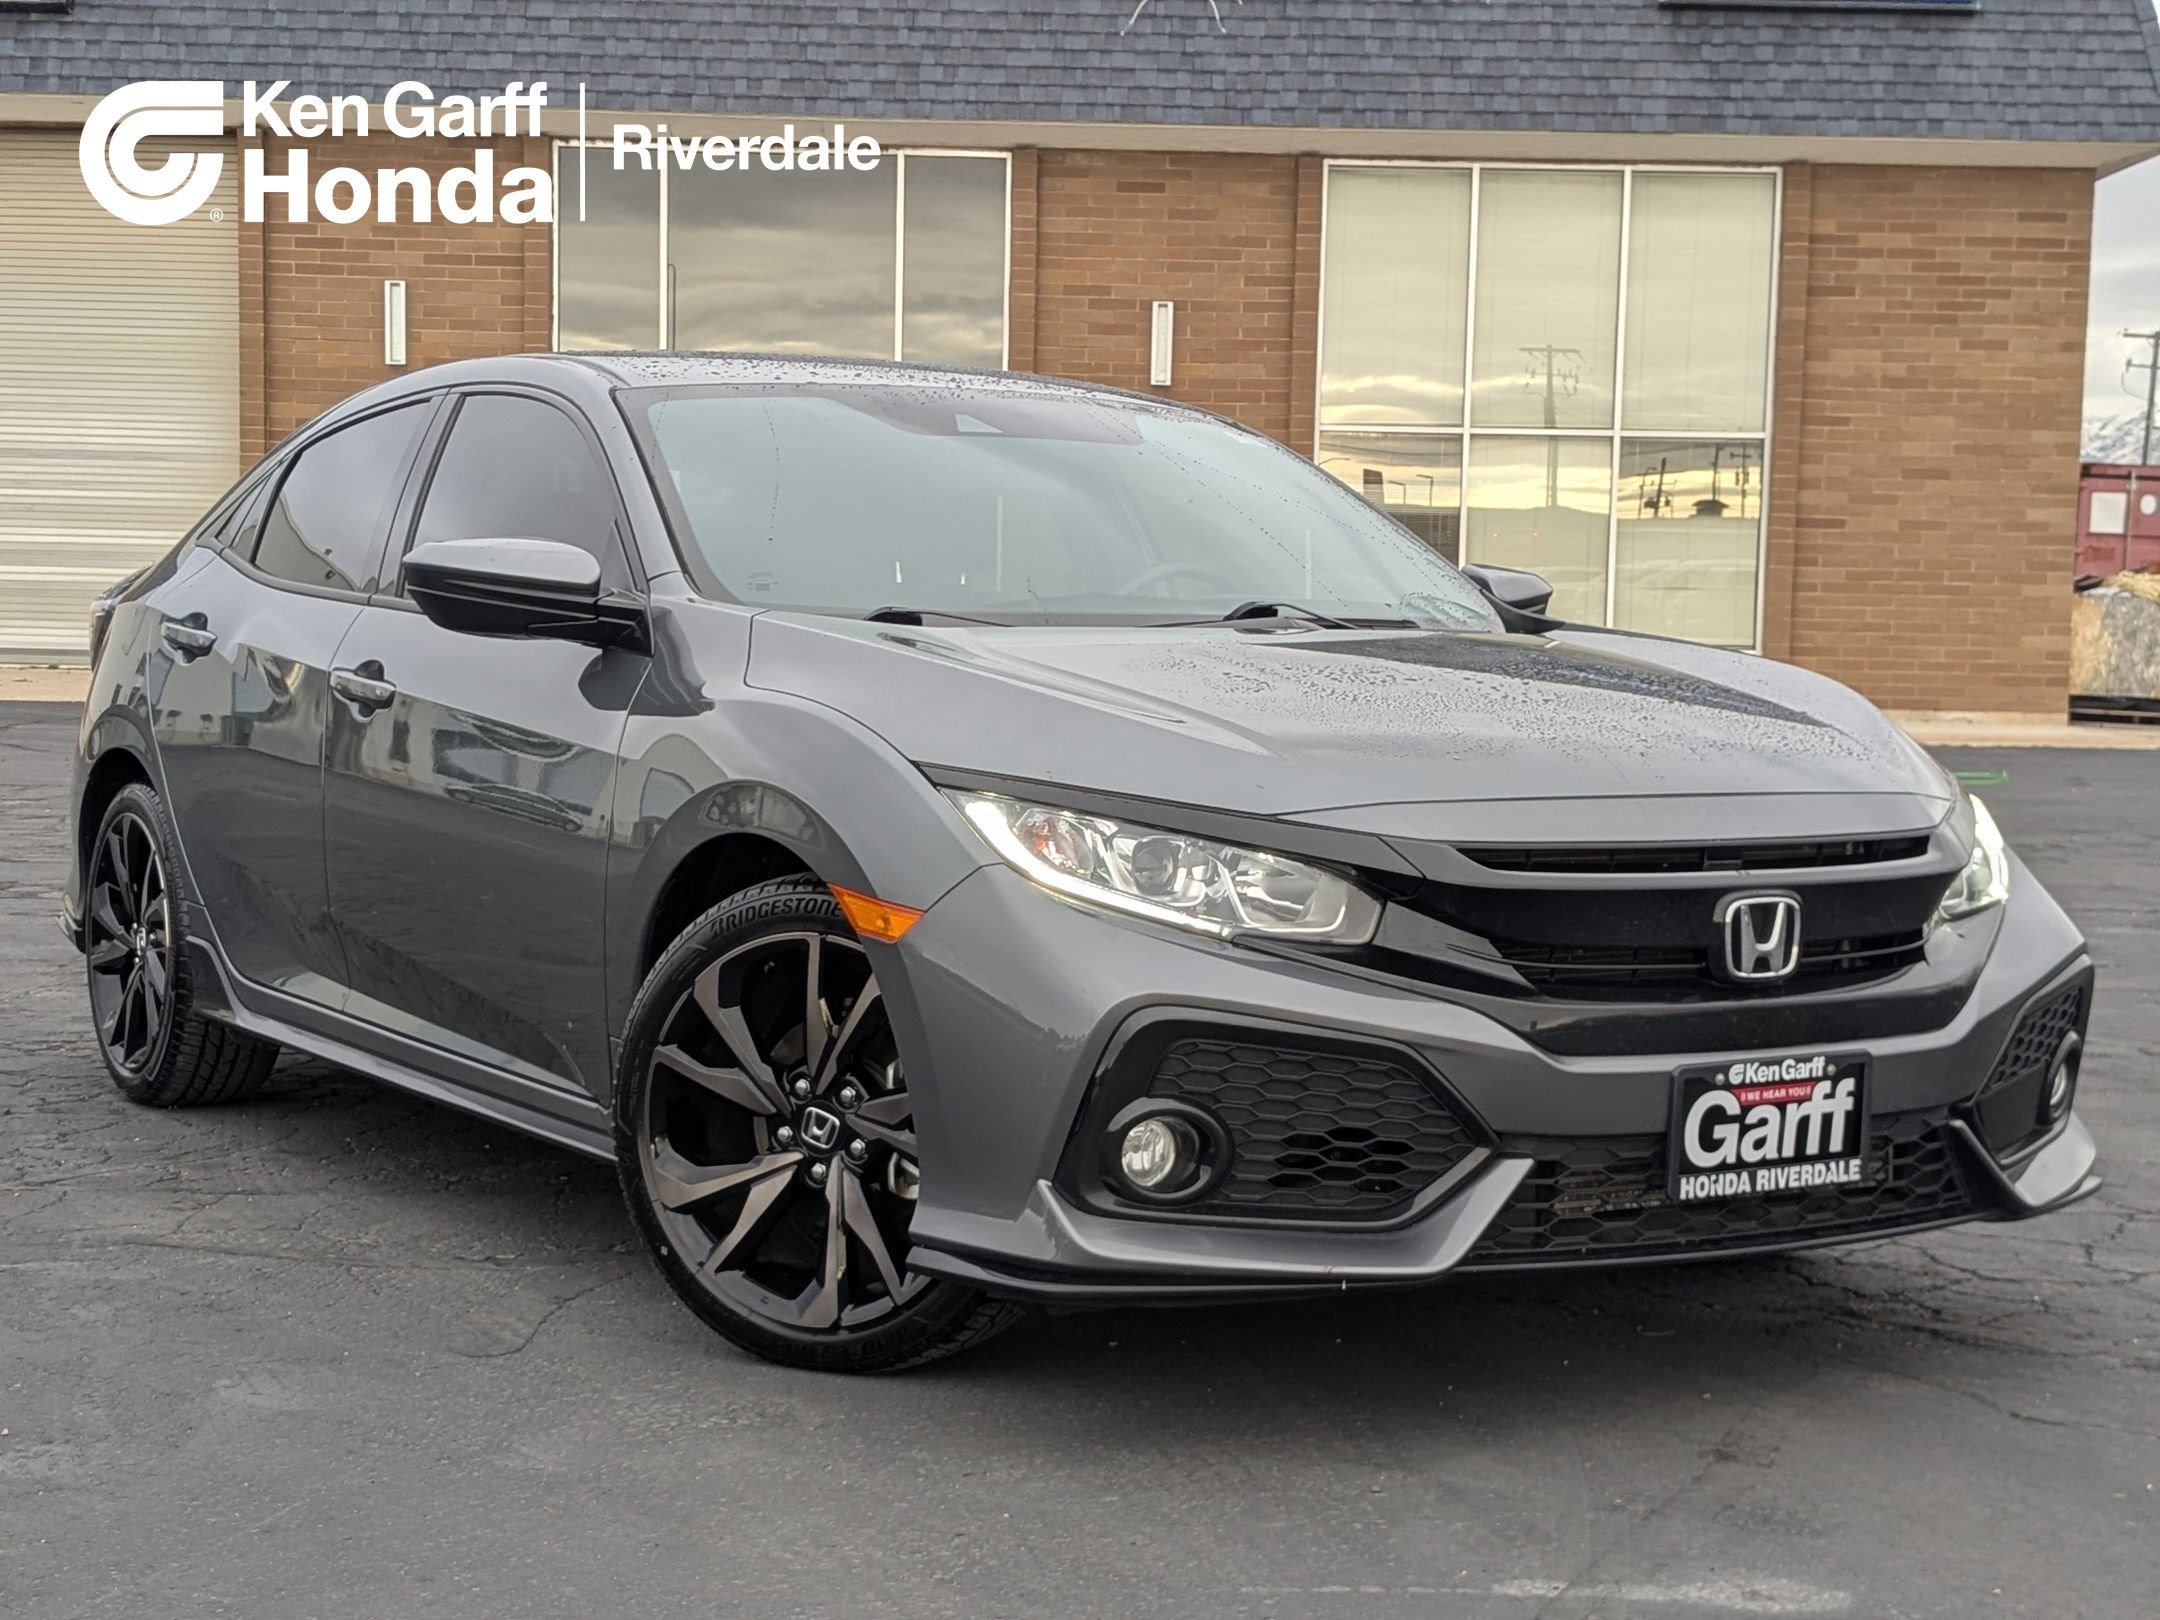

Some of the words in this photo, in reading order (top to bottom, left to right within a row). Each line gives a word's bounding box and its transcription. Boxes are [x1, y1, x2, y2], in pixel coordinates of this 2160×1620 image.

[711, 897, 843, 940] BRIDGESTONE
[1744, 1061, 1781, 1084] Ken
[1781, 1055, 1827, 1081] Garff
[1747, 1091, 1761, 1101] WE
[1762, 1089, 1786, 1100] HEAR
[1683, 1076, 1856, 1169] Garff
[1679, 1170, 1752, 1200] HONDA
[1755, 1158, 1863, 1192] RIVERDALE
